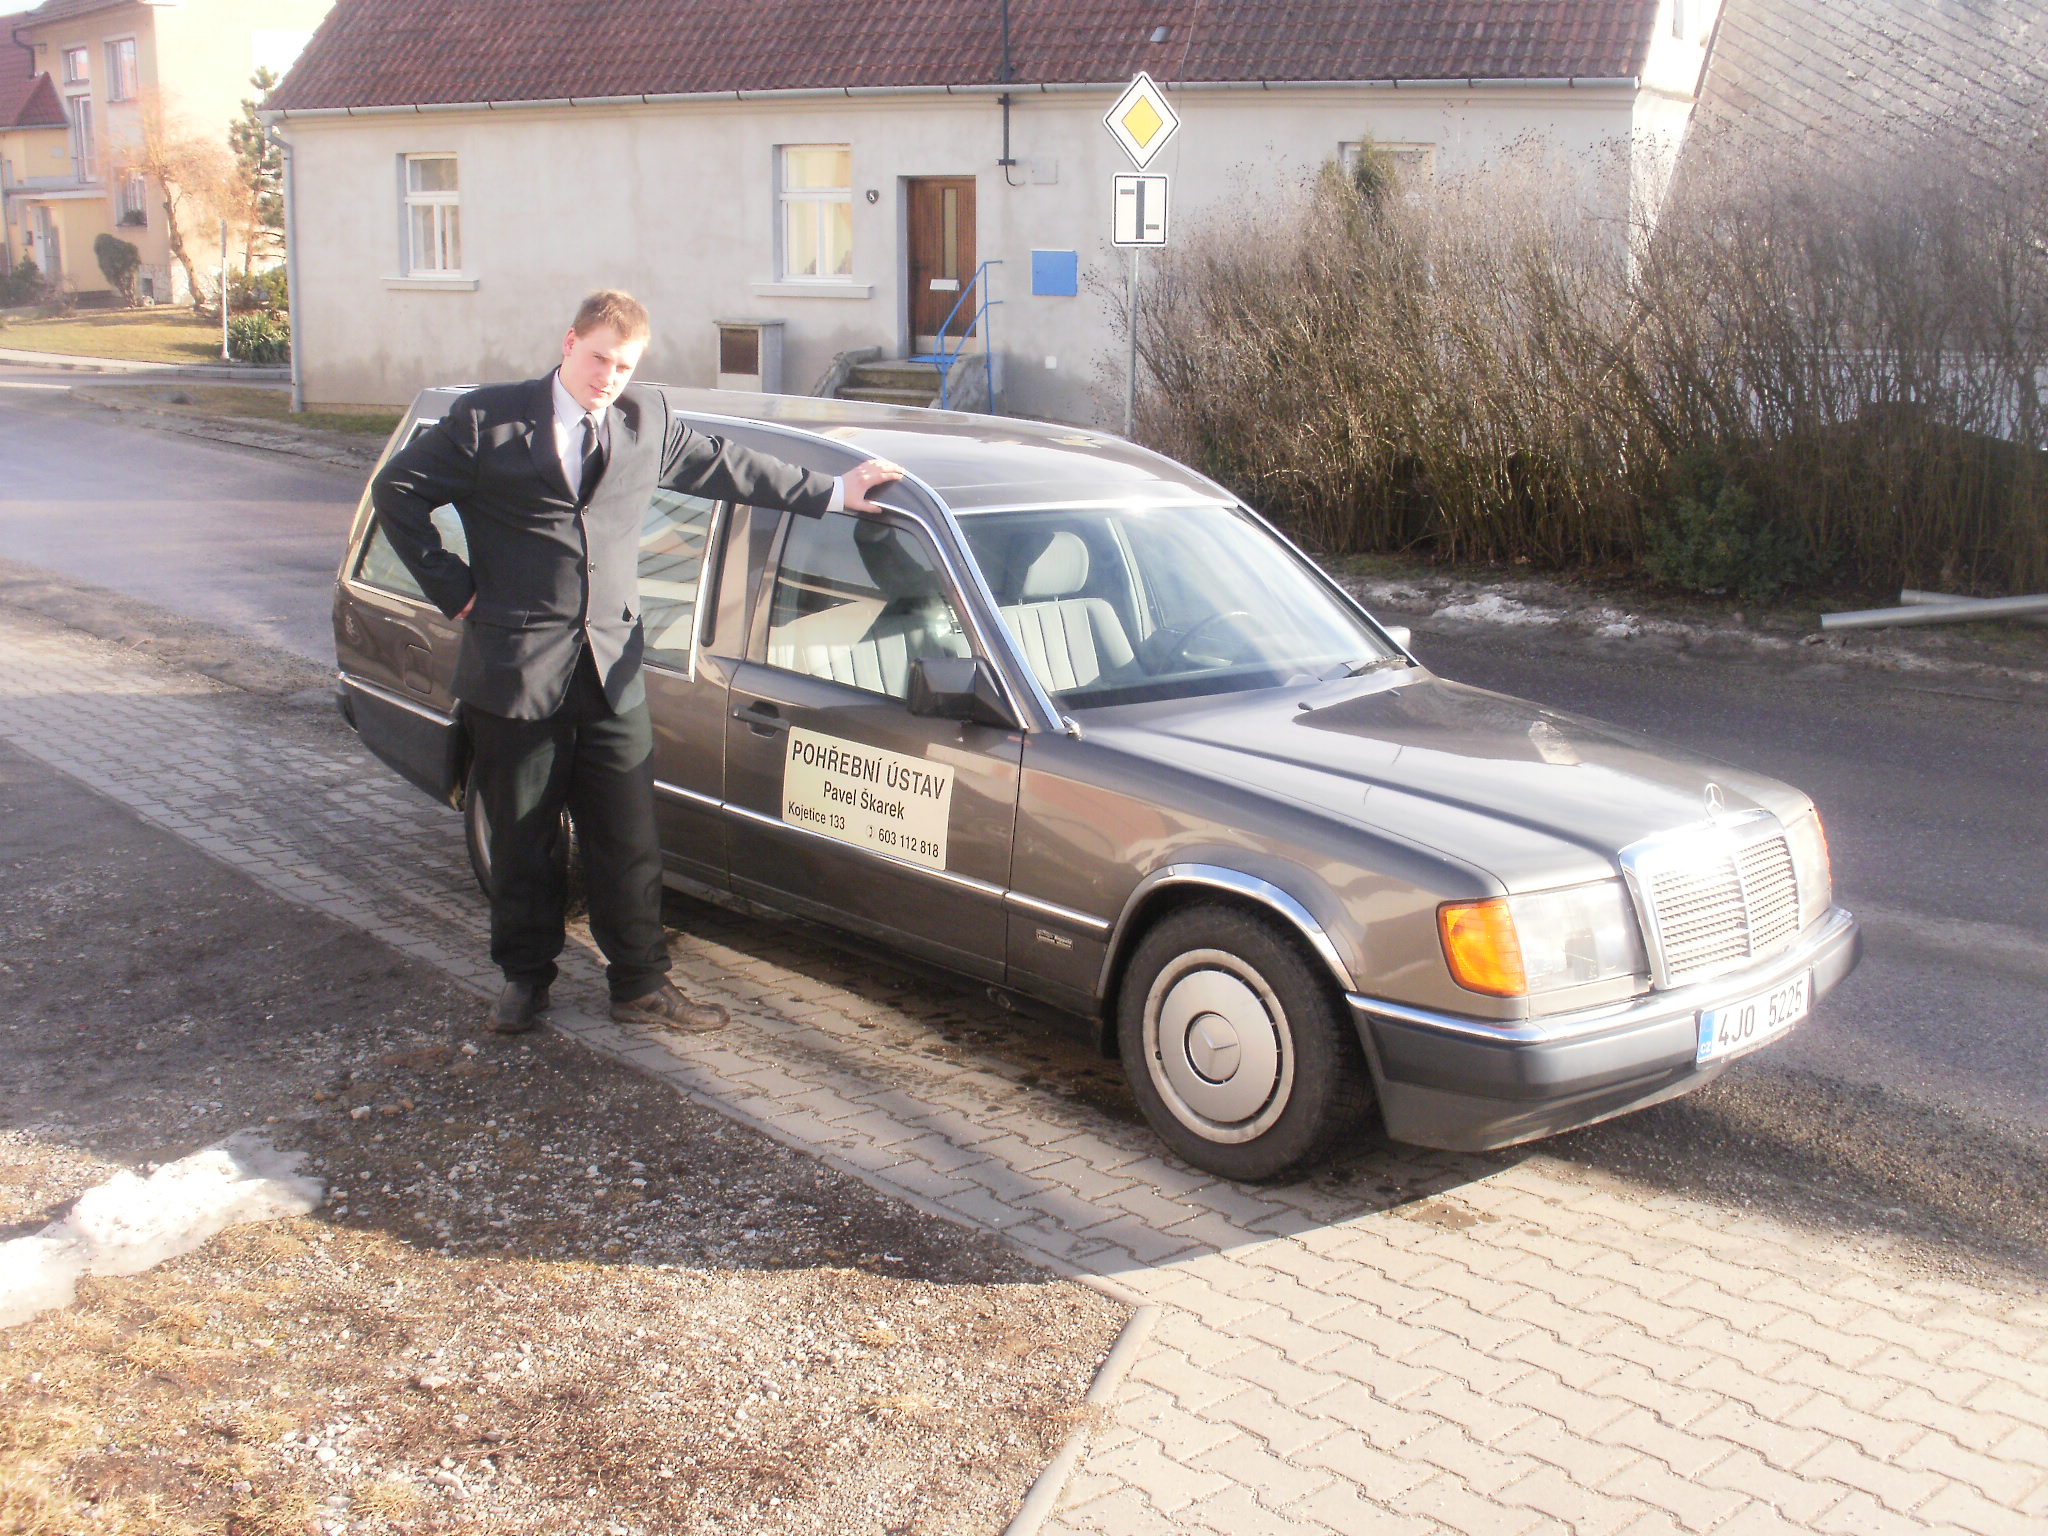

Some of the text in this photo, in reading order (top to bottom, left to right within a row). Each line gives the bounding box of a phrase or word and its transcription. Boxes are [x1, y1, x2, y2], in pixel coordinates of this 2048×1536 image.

[792, 740, 945, 799] POHŘEBNÍ ÚSTAV
[788, 801, 845, 830] Kojetice 133
[823, 780, 905, 820] Pavel Škarek
[878, 828, 939, 858] 603 112 818
[1768, 980, 1803, 1027] 5225
[1701, 1041, 1712, 1054] CZ
